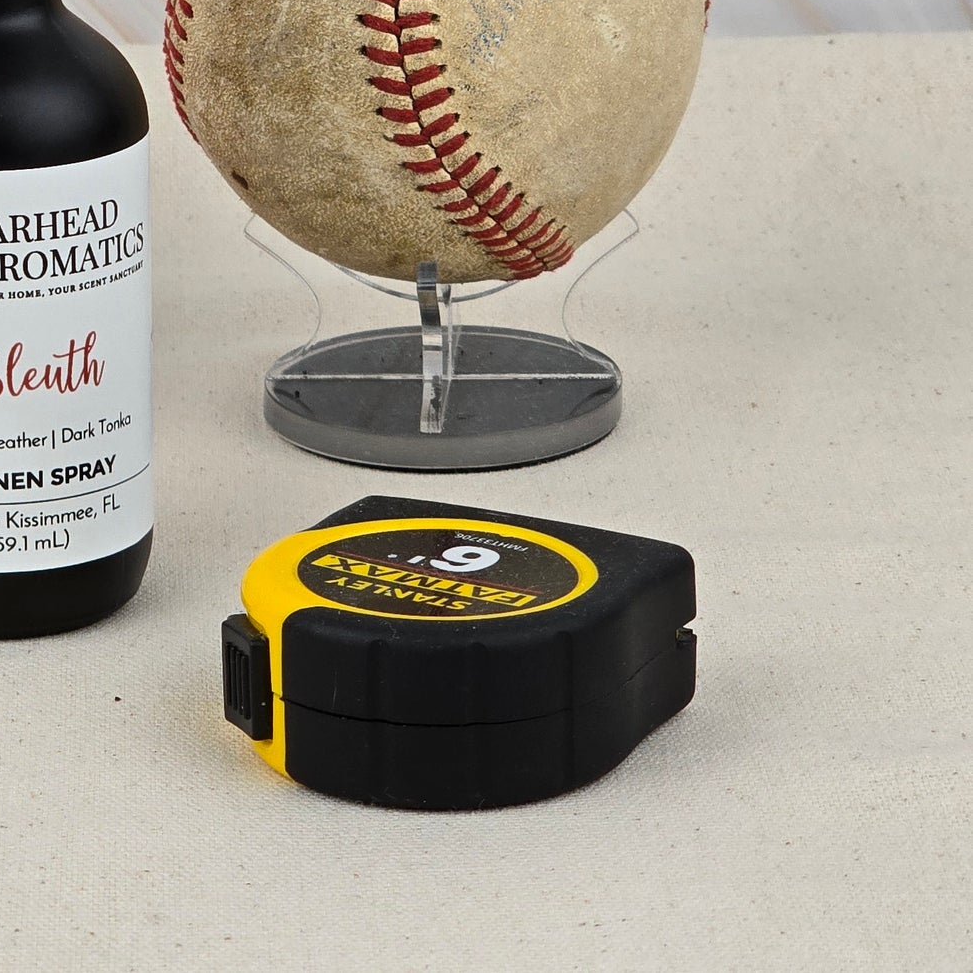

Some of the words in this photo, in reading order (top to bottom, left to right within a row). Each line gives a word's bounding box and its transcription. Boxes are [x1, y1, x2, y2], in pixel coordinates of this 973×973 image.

[8, 289, 45, 300] HOME,
[48, 284, 77, 297] YOUR
[78, 276, 107, 292] SCENT
[109, 259, 145, 284] SANCTUARY
[61, 421, 96, 444] Dark
[98, 412, 132, 435] Tonka
[49, 454, 117, 486] SPRAY
[6, 507, 98, 530] Kissimmee,
[102, 492, 121, 515] FL
[35, 528, 70, 550] mL)
[325, 576, 473, 611] STANLEY
[329, 556, 530, 606] FATMAX
